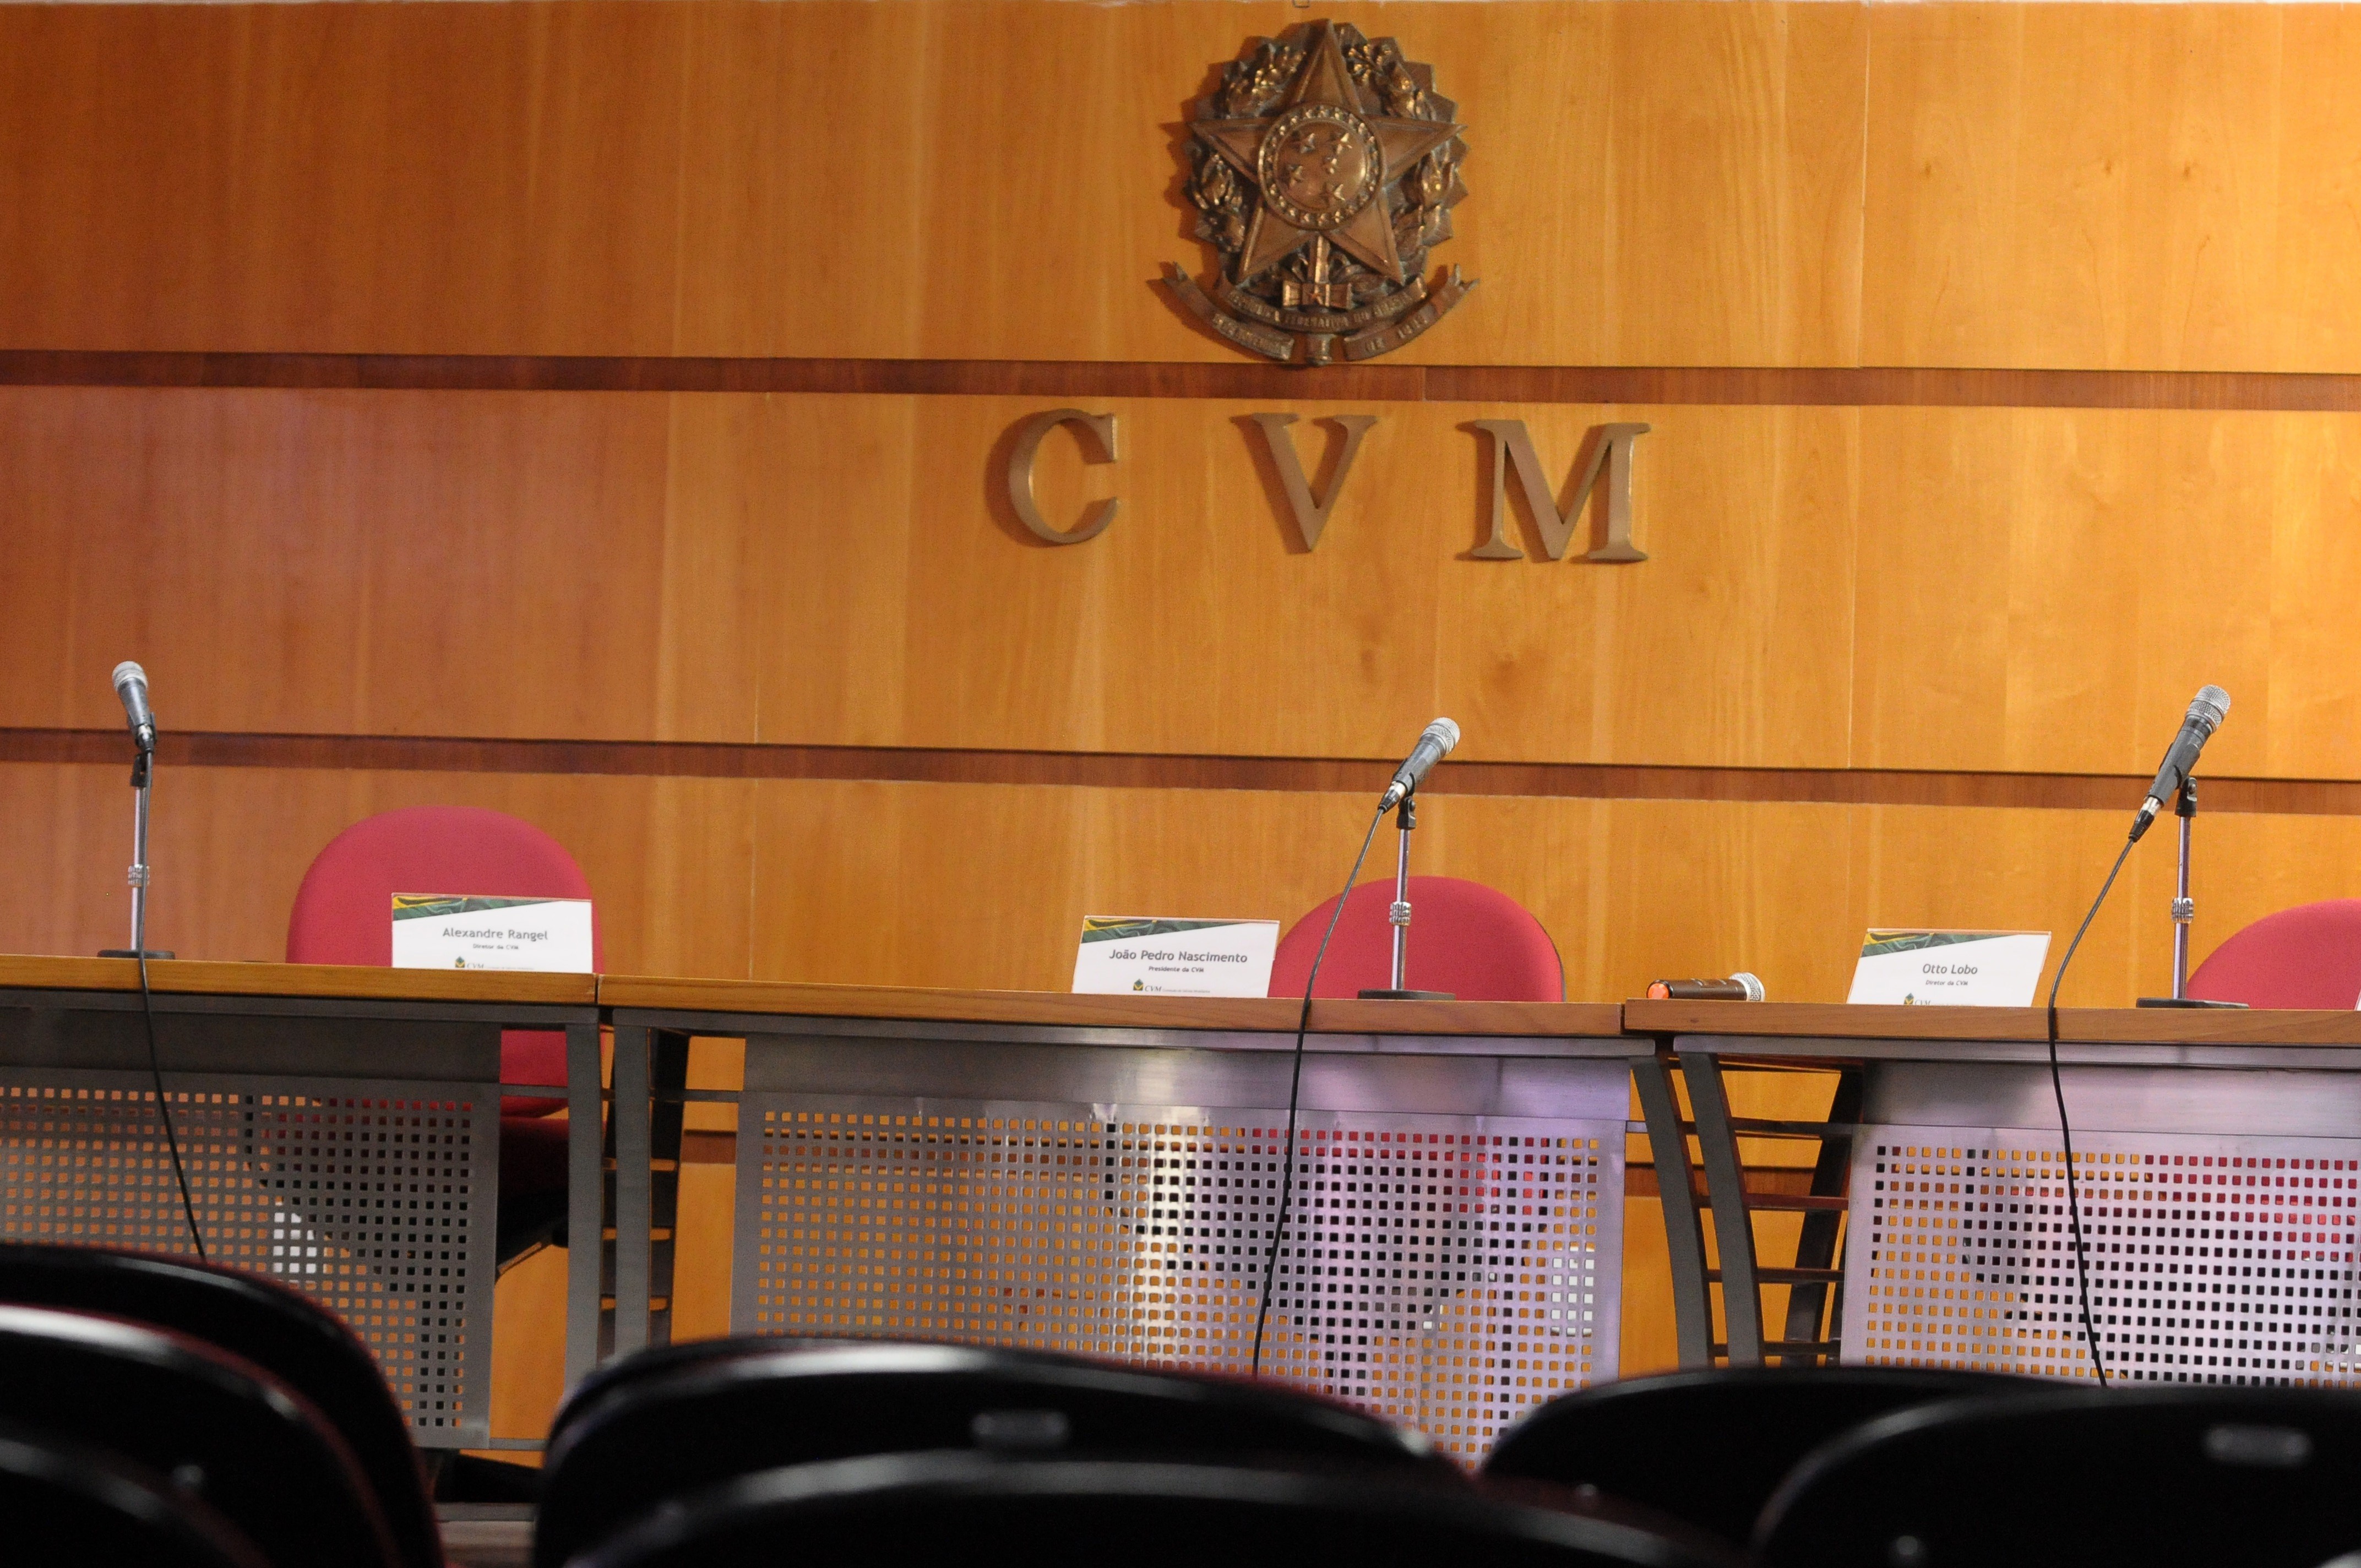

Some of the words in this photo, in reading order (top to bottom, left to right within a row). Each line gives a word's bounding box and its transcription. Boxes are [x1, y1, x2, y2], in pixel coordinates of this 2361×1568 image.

[1007, 407, 1651, 560] CVM
[442, 927, 503, 939] Alexandre
[508, 929, 548, 942] Rangel
[1109, 949, 1137, 960] João
[1140, 950, 1174, 961] Pedro
[1178, 951, 1248, 963] Nascimento
[1922, 963, 1947, 974] Otto
[1951, 964, 1978, 975] Lobo
